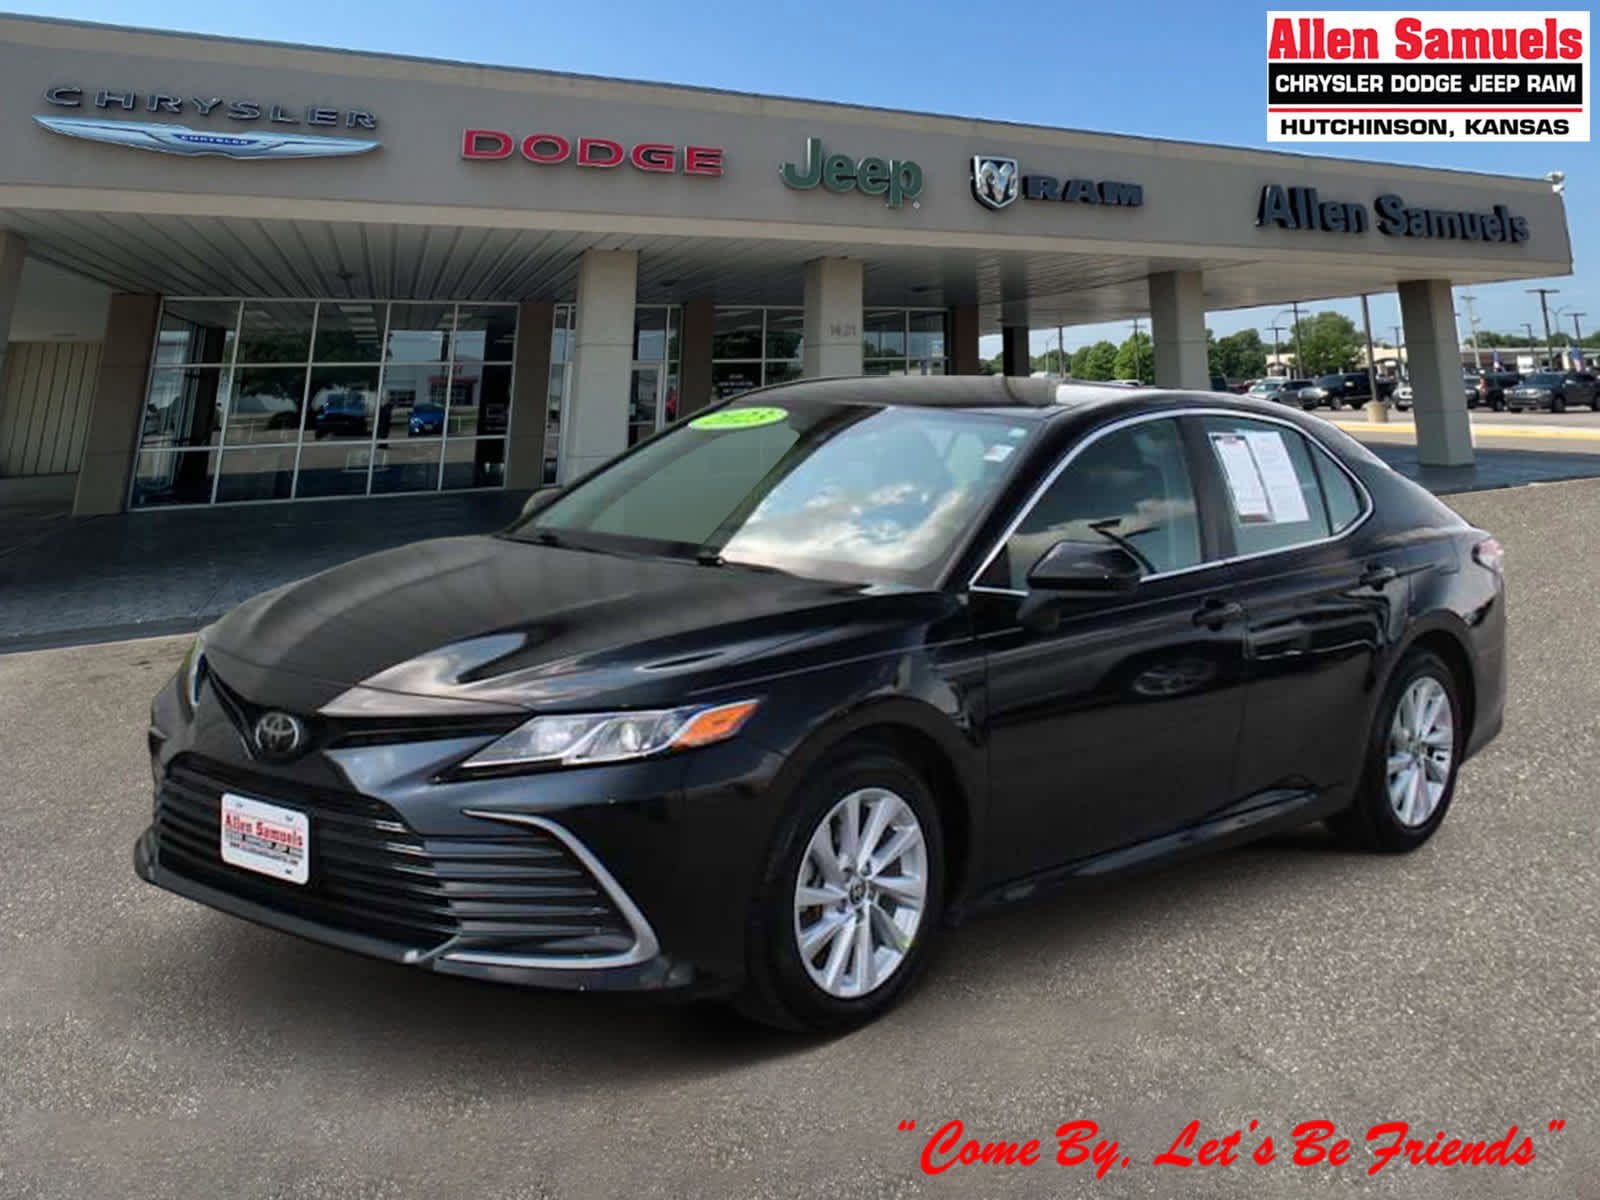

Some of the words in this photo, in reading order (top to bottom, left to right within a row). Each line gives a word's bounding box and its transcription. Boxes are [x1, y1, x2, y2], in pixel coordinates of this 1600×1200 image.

[44, 86, 377, 129] CHRYSLER
[461, 128, 725, 176] DODGE
[779, 136, 924, 208] Jeep
[1022, 175, 1144, 208] RAM
[1255, 184, 1369, 233] Allen
[1374, 193, 1530, 242] Samuels
